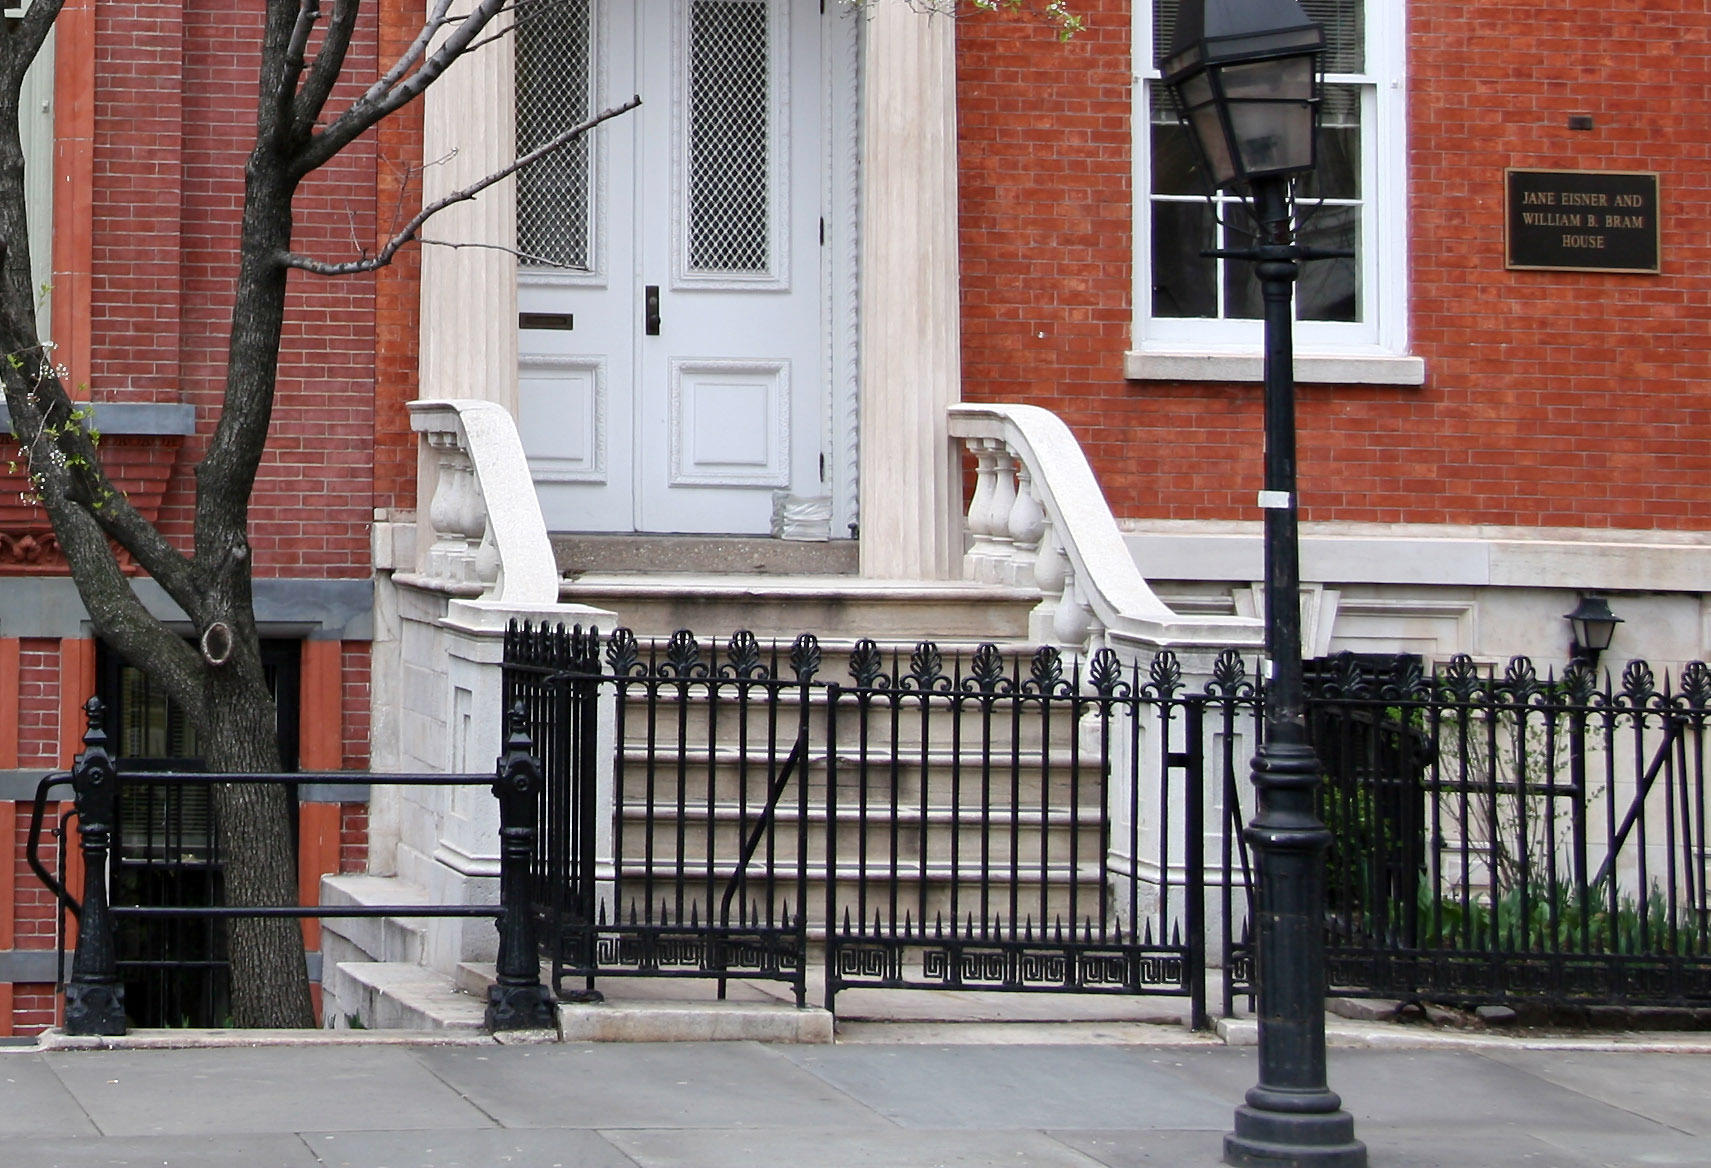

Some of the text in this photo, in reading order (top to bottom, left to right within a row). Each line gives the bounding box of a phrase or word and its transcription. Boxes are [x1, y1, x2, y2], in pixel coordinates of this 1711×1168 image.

[1523, 192, 1642, 208] JANE EISNER AND
[1522, 213, 1644, 229] WILLIAM B. BRAM
[1562, 234, 1605, 249] HOUSE
